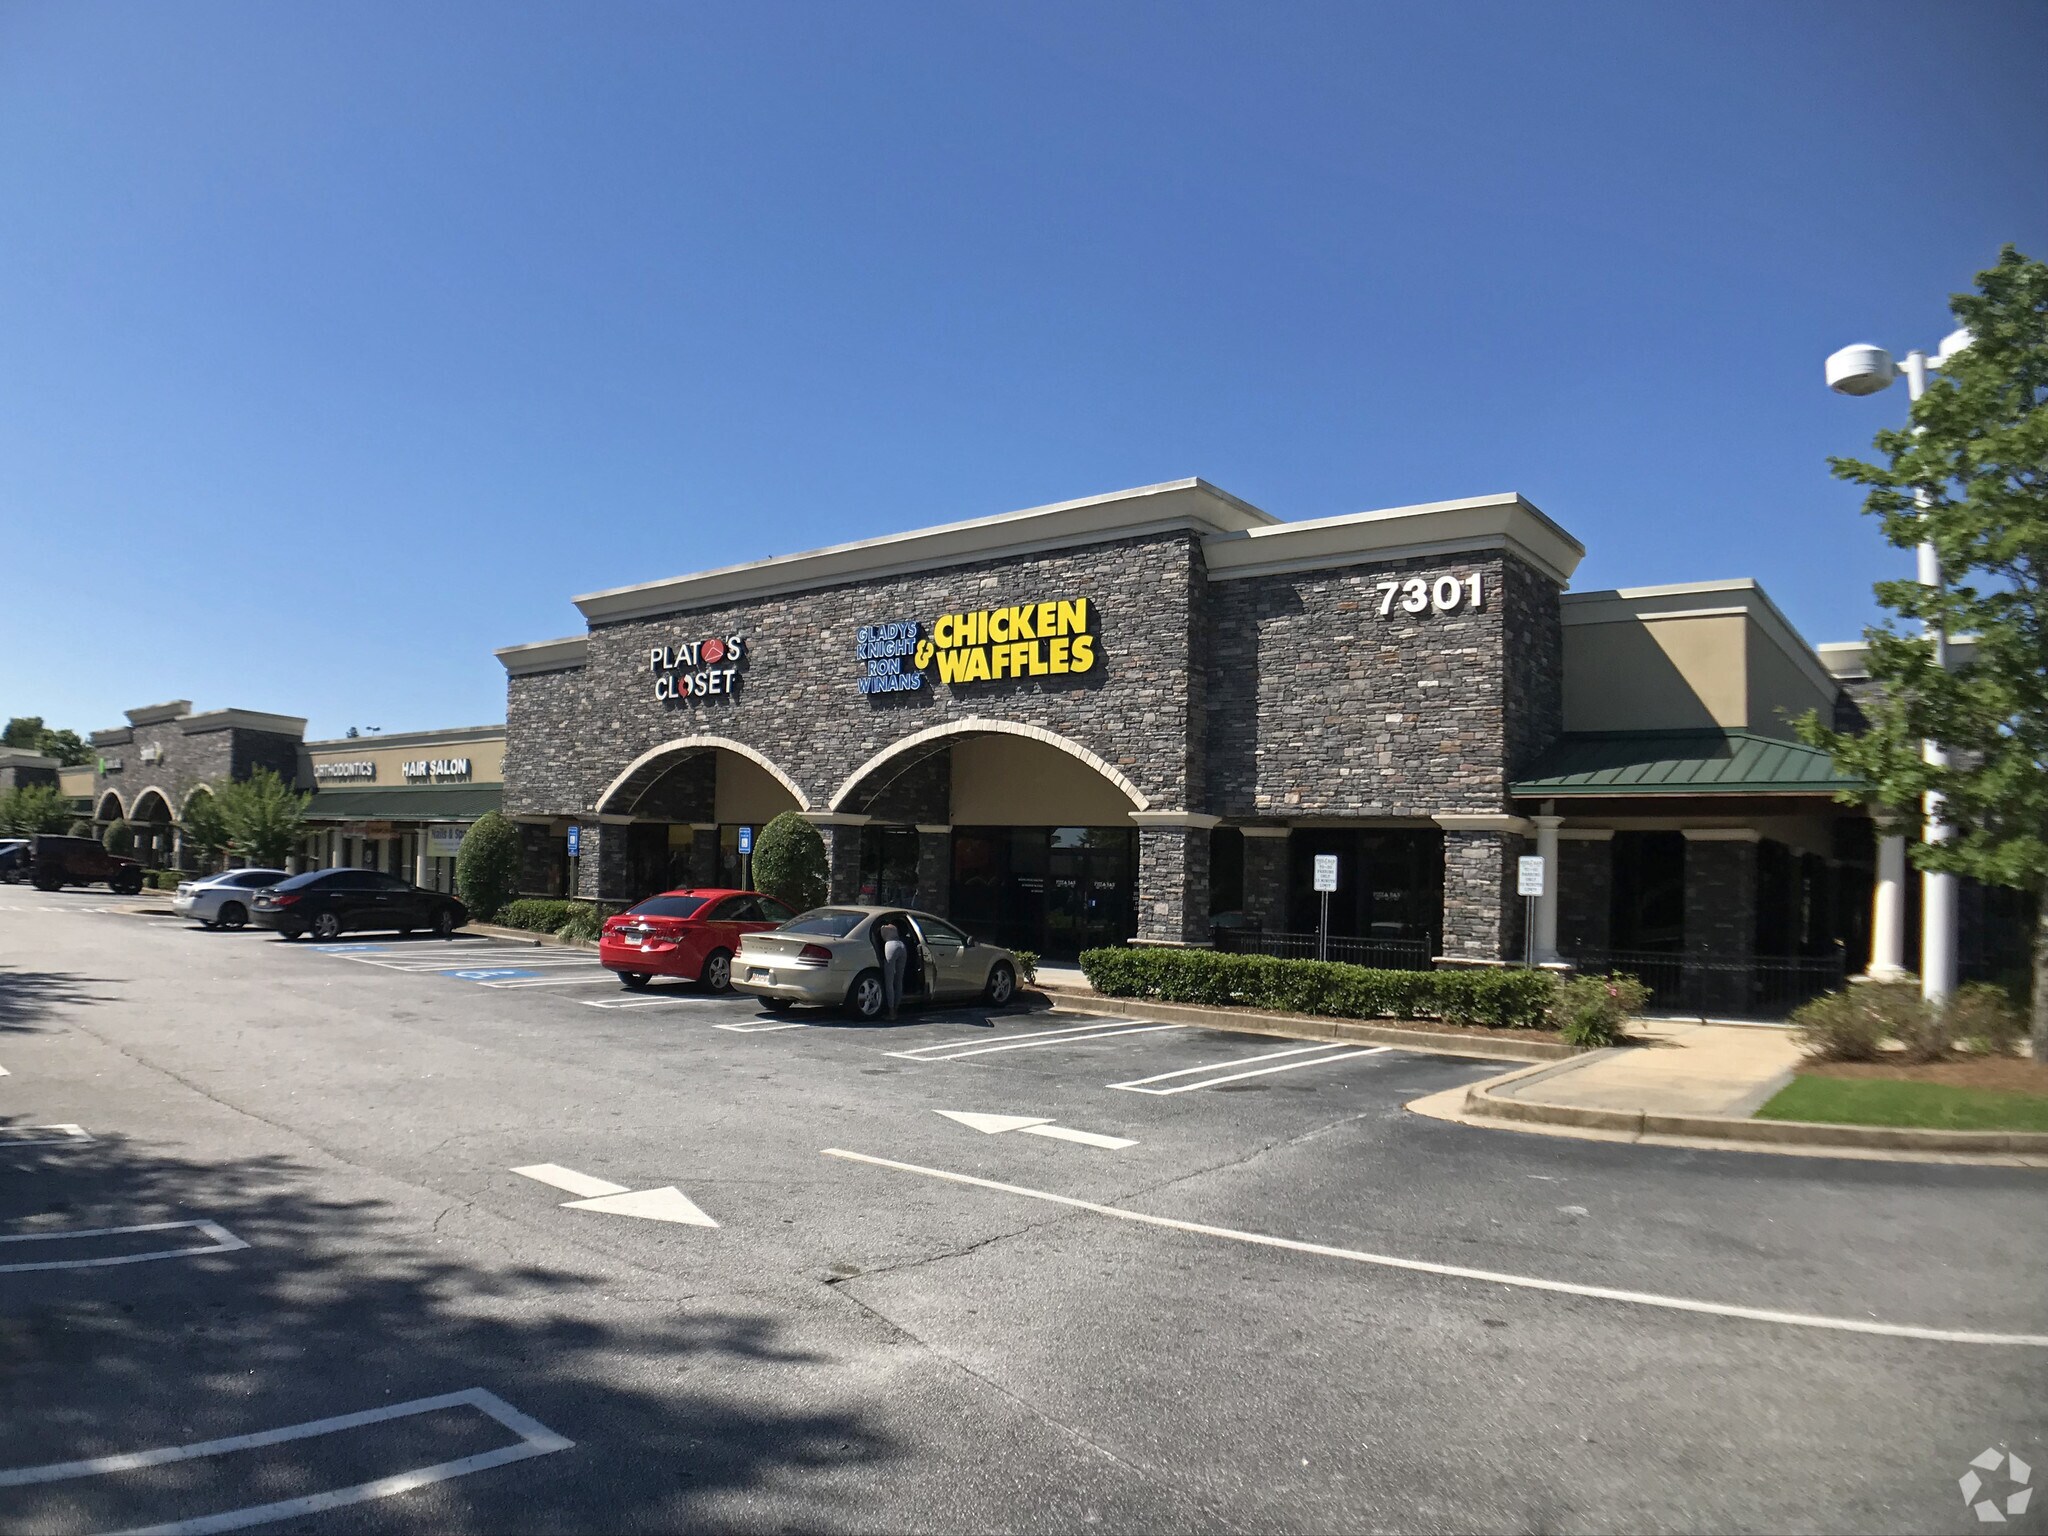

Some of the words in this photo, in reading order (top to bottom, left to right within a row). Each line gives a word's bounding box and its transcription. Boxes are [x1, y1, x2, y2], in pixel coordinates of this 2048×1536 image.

[1376, 573, 1481, 616] 7301
[856, 620, 917, 643] GLADYS
[933, 598, 1087, 649] CHICKEN
[650, 635, 741, 671] PLATO'S
[856, 638, 917, 660] KNIGHT
[914, 639, 935, 670] &
[936, 635, 1095, 685] WAFFLES
[867, 658, 901, 677] RON
[655, 669, 735, 701] CLOSET
[857, 672, 921, 694] WINANS
[314, 761, 374, 777] ORTHODONTICS
[401, 760, 427, 777] HAIR
[429, 758, 468, 775] SALON
